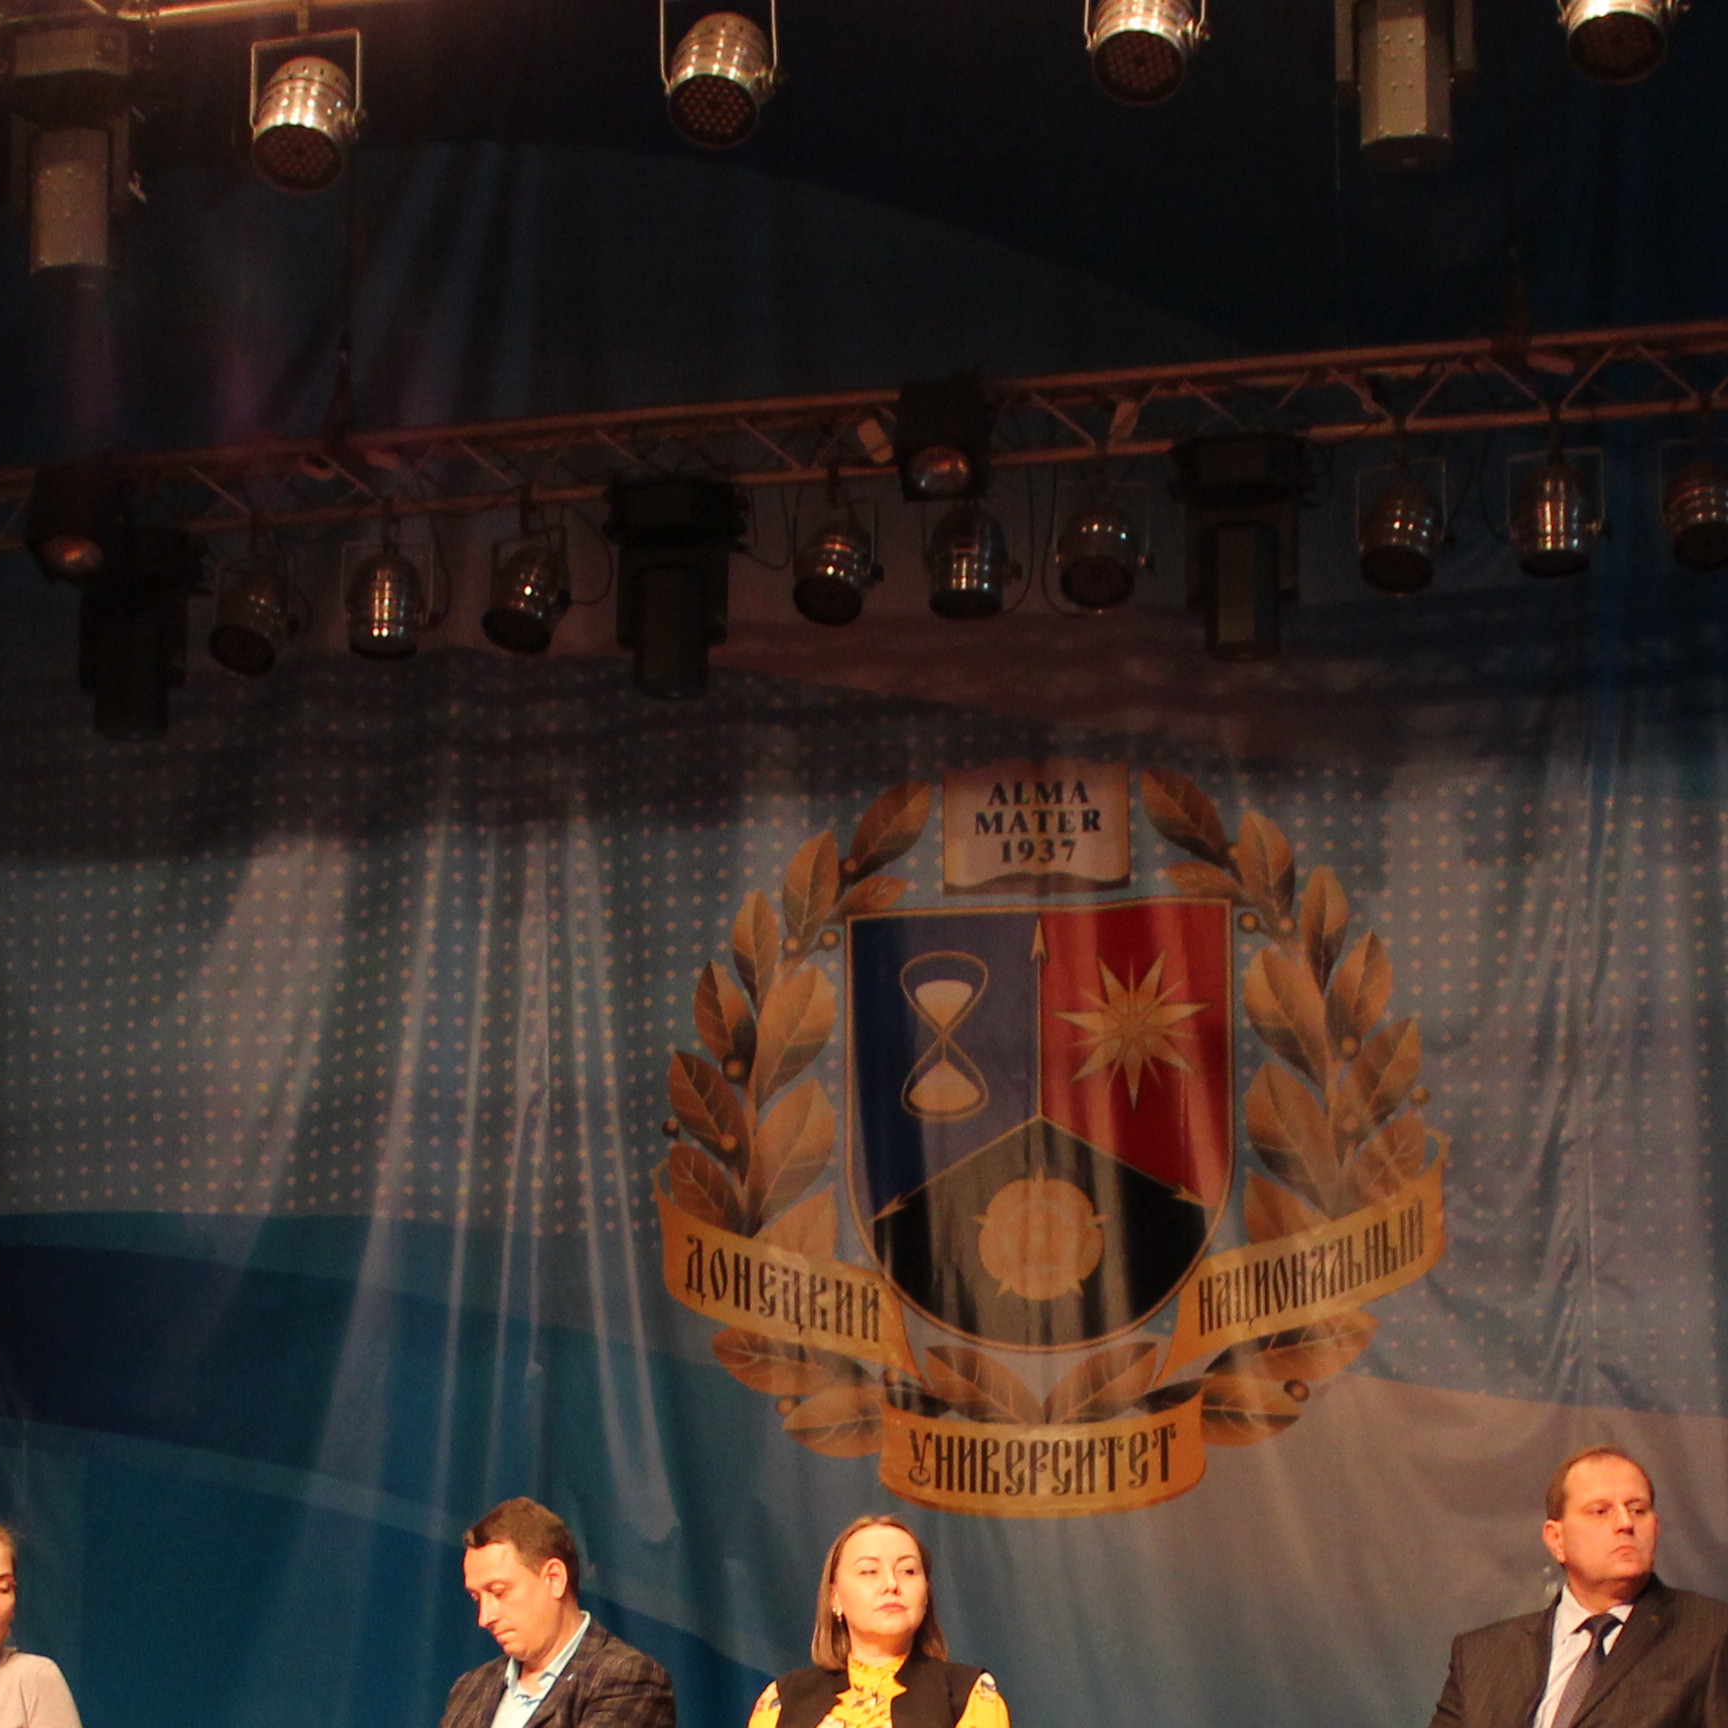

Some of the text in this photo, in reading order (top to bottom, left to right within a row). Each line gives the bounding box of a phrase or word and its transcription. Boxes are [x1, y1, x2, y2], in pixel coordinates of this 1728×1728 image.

[987, 780, 1090, 806] ALMA
[974, 809, 1102, 836] MATER
[1001, 838, 1076, 864] 1937
[908, 1423, 1177, 1497] УНИВЕРСИТЕТ
